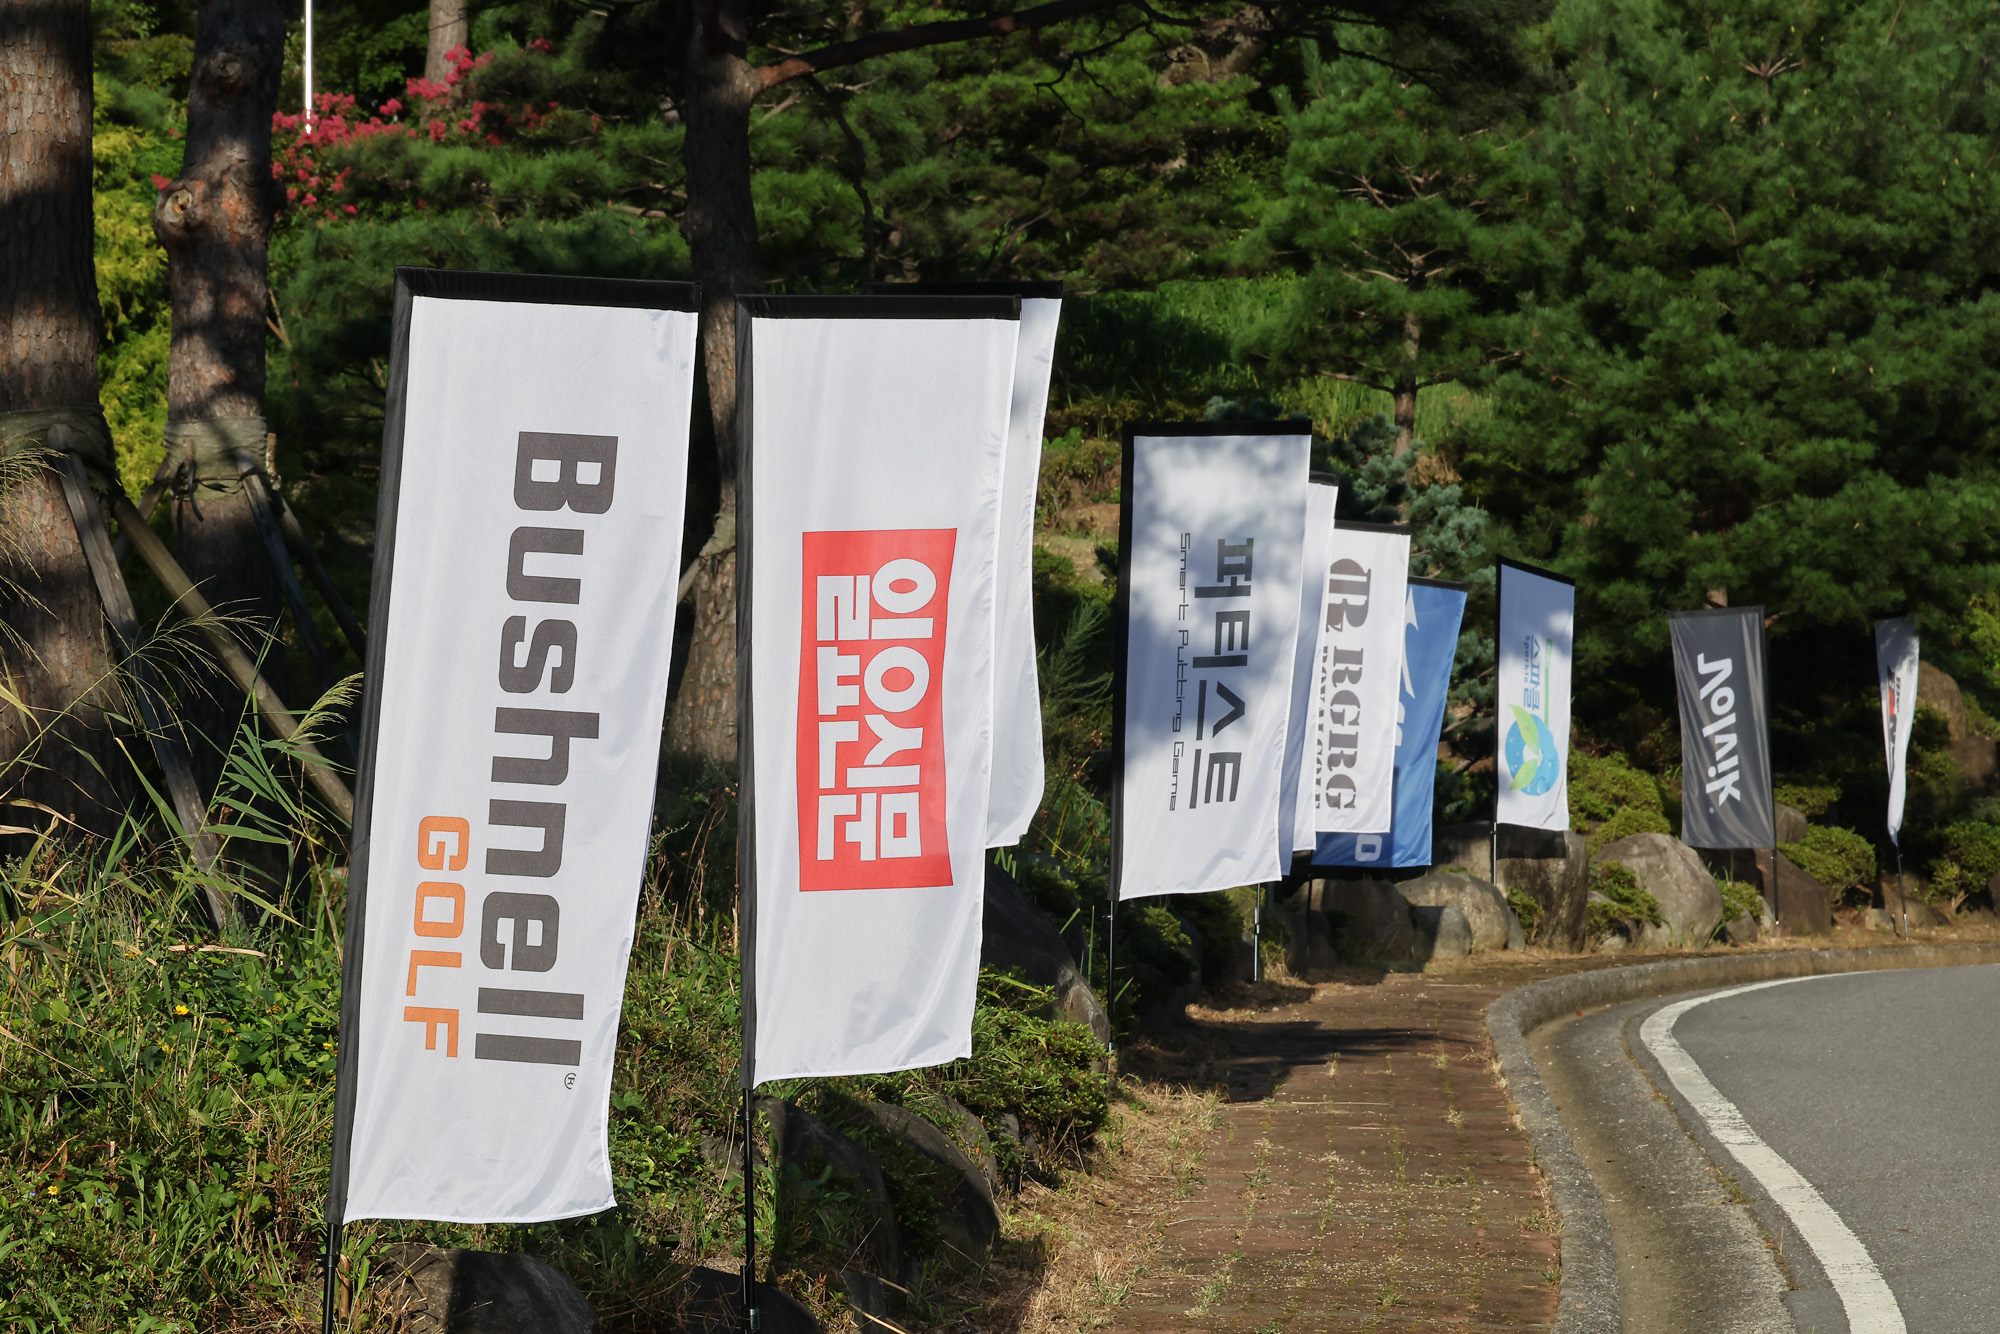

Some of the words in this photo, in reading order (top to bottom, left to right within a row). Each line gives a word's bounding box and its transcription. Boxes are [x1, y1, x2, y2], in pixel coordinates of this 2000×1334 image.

[1179, 532, 1191, 621] Smart
[475, 431, 619, 1066] Bushnell
[817, 558, 937, 861] 일요신문
[1173, 629, 1190, 733] Putting
[1189, 537, 1254, 809] 퍼티스트
[1326, 646, 1364, 810] RGRG
[1524, 637, 1541, 711] 스파클
[1169, 741, 1185, 812] Game
[404, 816, 469, 1057] GOLF
